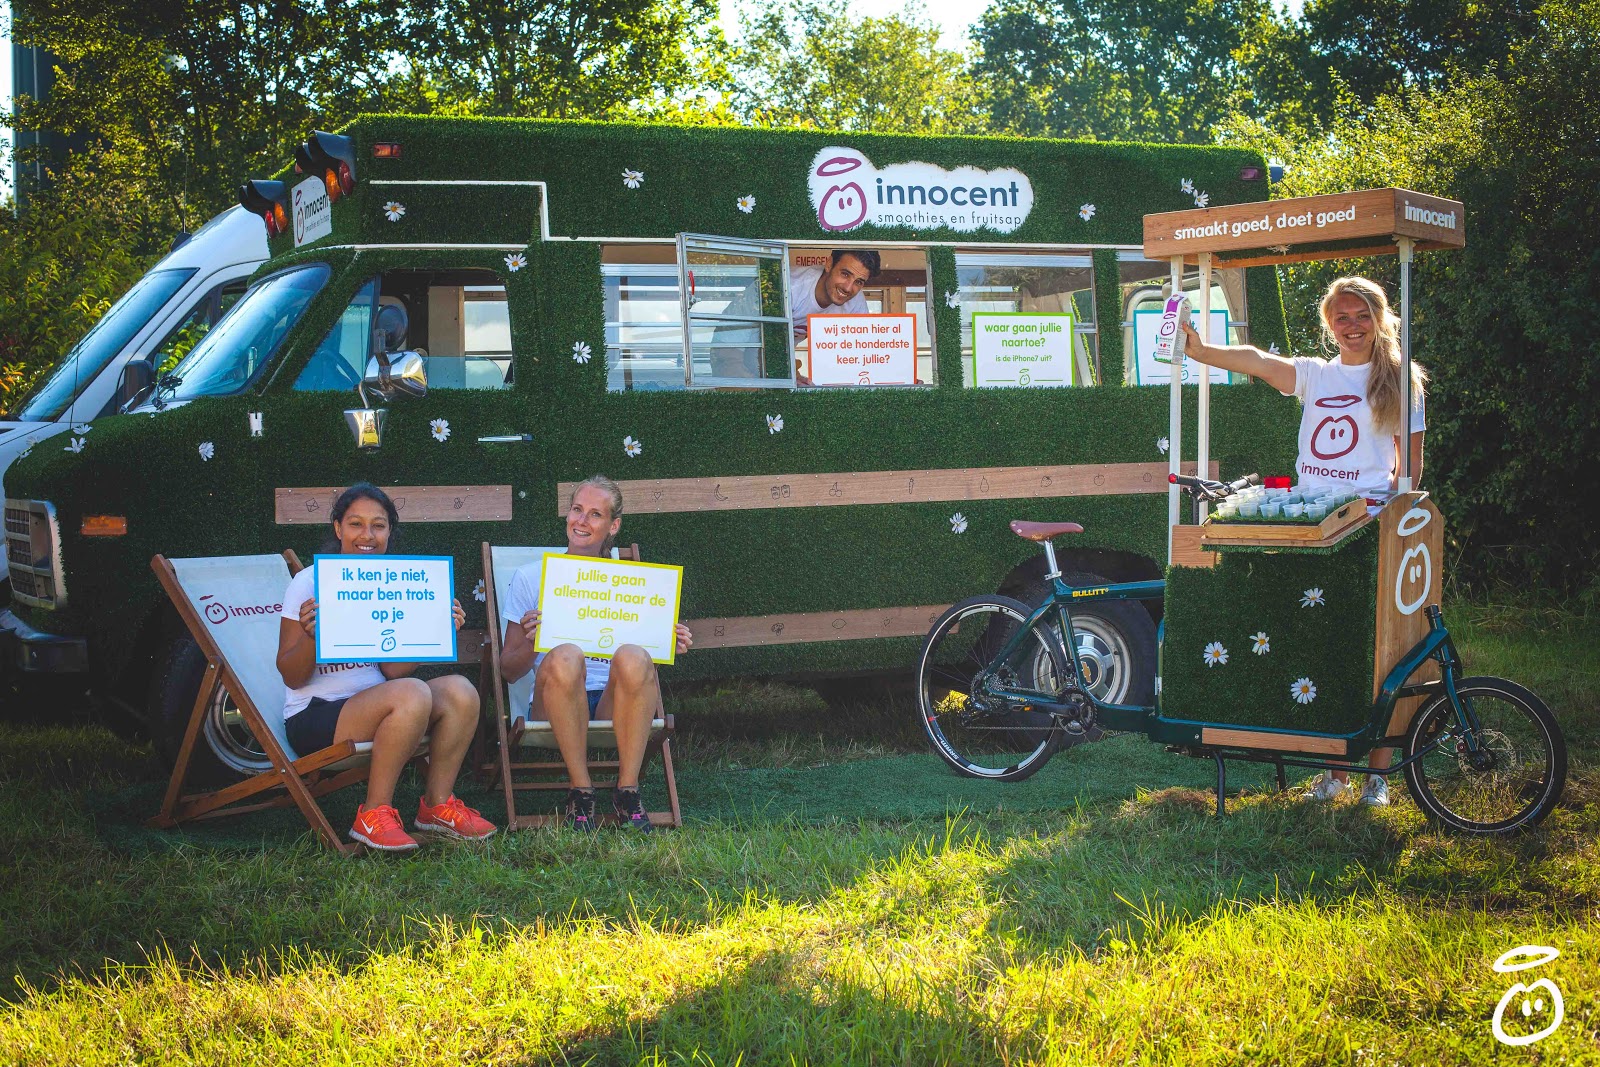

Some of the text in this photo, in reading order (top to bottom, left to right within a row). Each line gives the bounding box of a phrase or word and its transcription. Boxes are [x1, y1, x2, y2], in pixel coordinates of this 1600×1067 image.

[876, 177, 1019, 206] innocent
[878, 210, 1022, 227] smoothies en fruitsap
[1174, 205, 1356, 240] smaakt goed, doet goed
[1405, 200, 1456, 229] innocent
[824, 324, 901, 336] wij staan hier al
[984, 322, 1062, 335] waar gaan jullie
[815, 339, 910, 350] voor de honderdste
[1001, 338, 1046, 347] naartoe?
[836, 354, 890, 366] keer. jullie?
[1301, 462, 1360, 480] innocent
[342, 568, 429, 584] ik ken je niet,
[576, 568, 646, 587] jullie gaan
[337, 587, 436, 600] maar ben trots
[554, 584, 667, 607] allemaal naar de
[228, 603, 283, 617] innoce
[371, 606, 404, 624] op je
[577, 605, 639, 622] gladiolen
